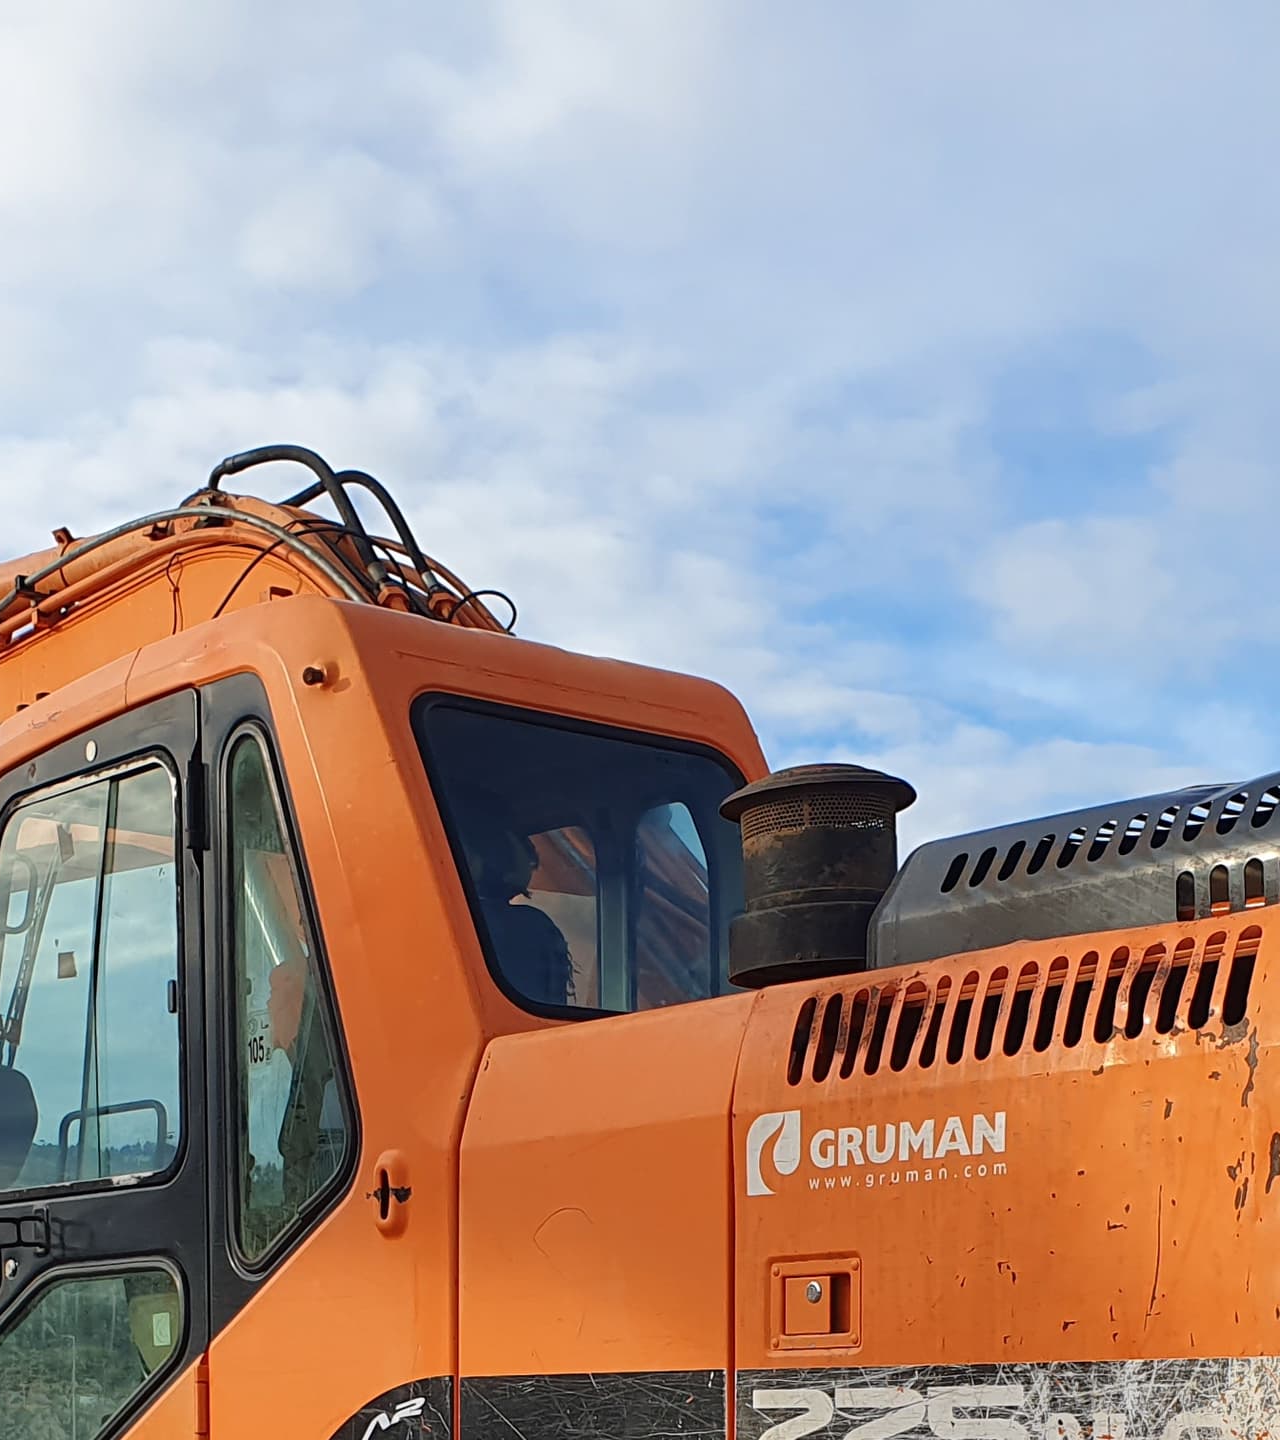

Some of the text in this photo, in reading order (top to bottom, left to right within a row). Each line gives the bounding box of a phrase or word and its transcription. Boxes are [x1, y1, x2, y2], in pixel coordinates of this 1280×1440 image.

[248, 1036, 264, 1063] 105
[810, 1111, 1006, 1169] GRUMAN
[808, 1162, 1007, 1190] www.gruman.com
